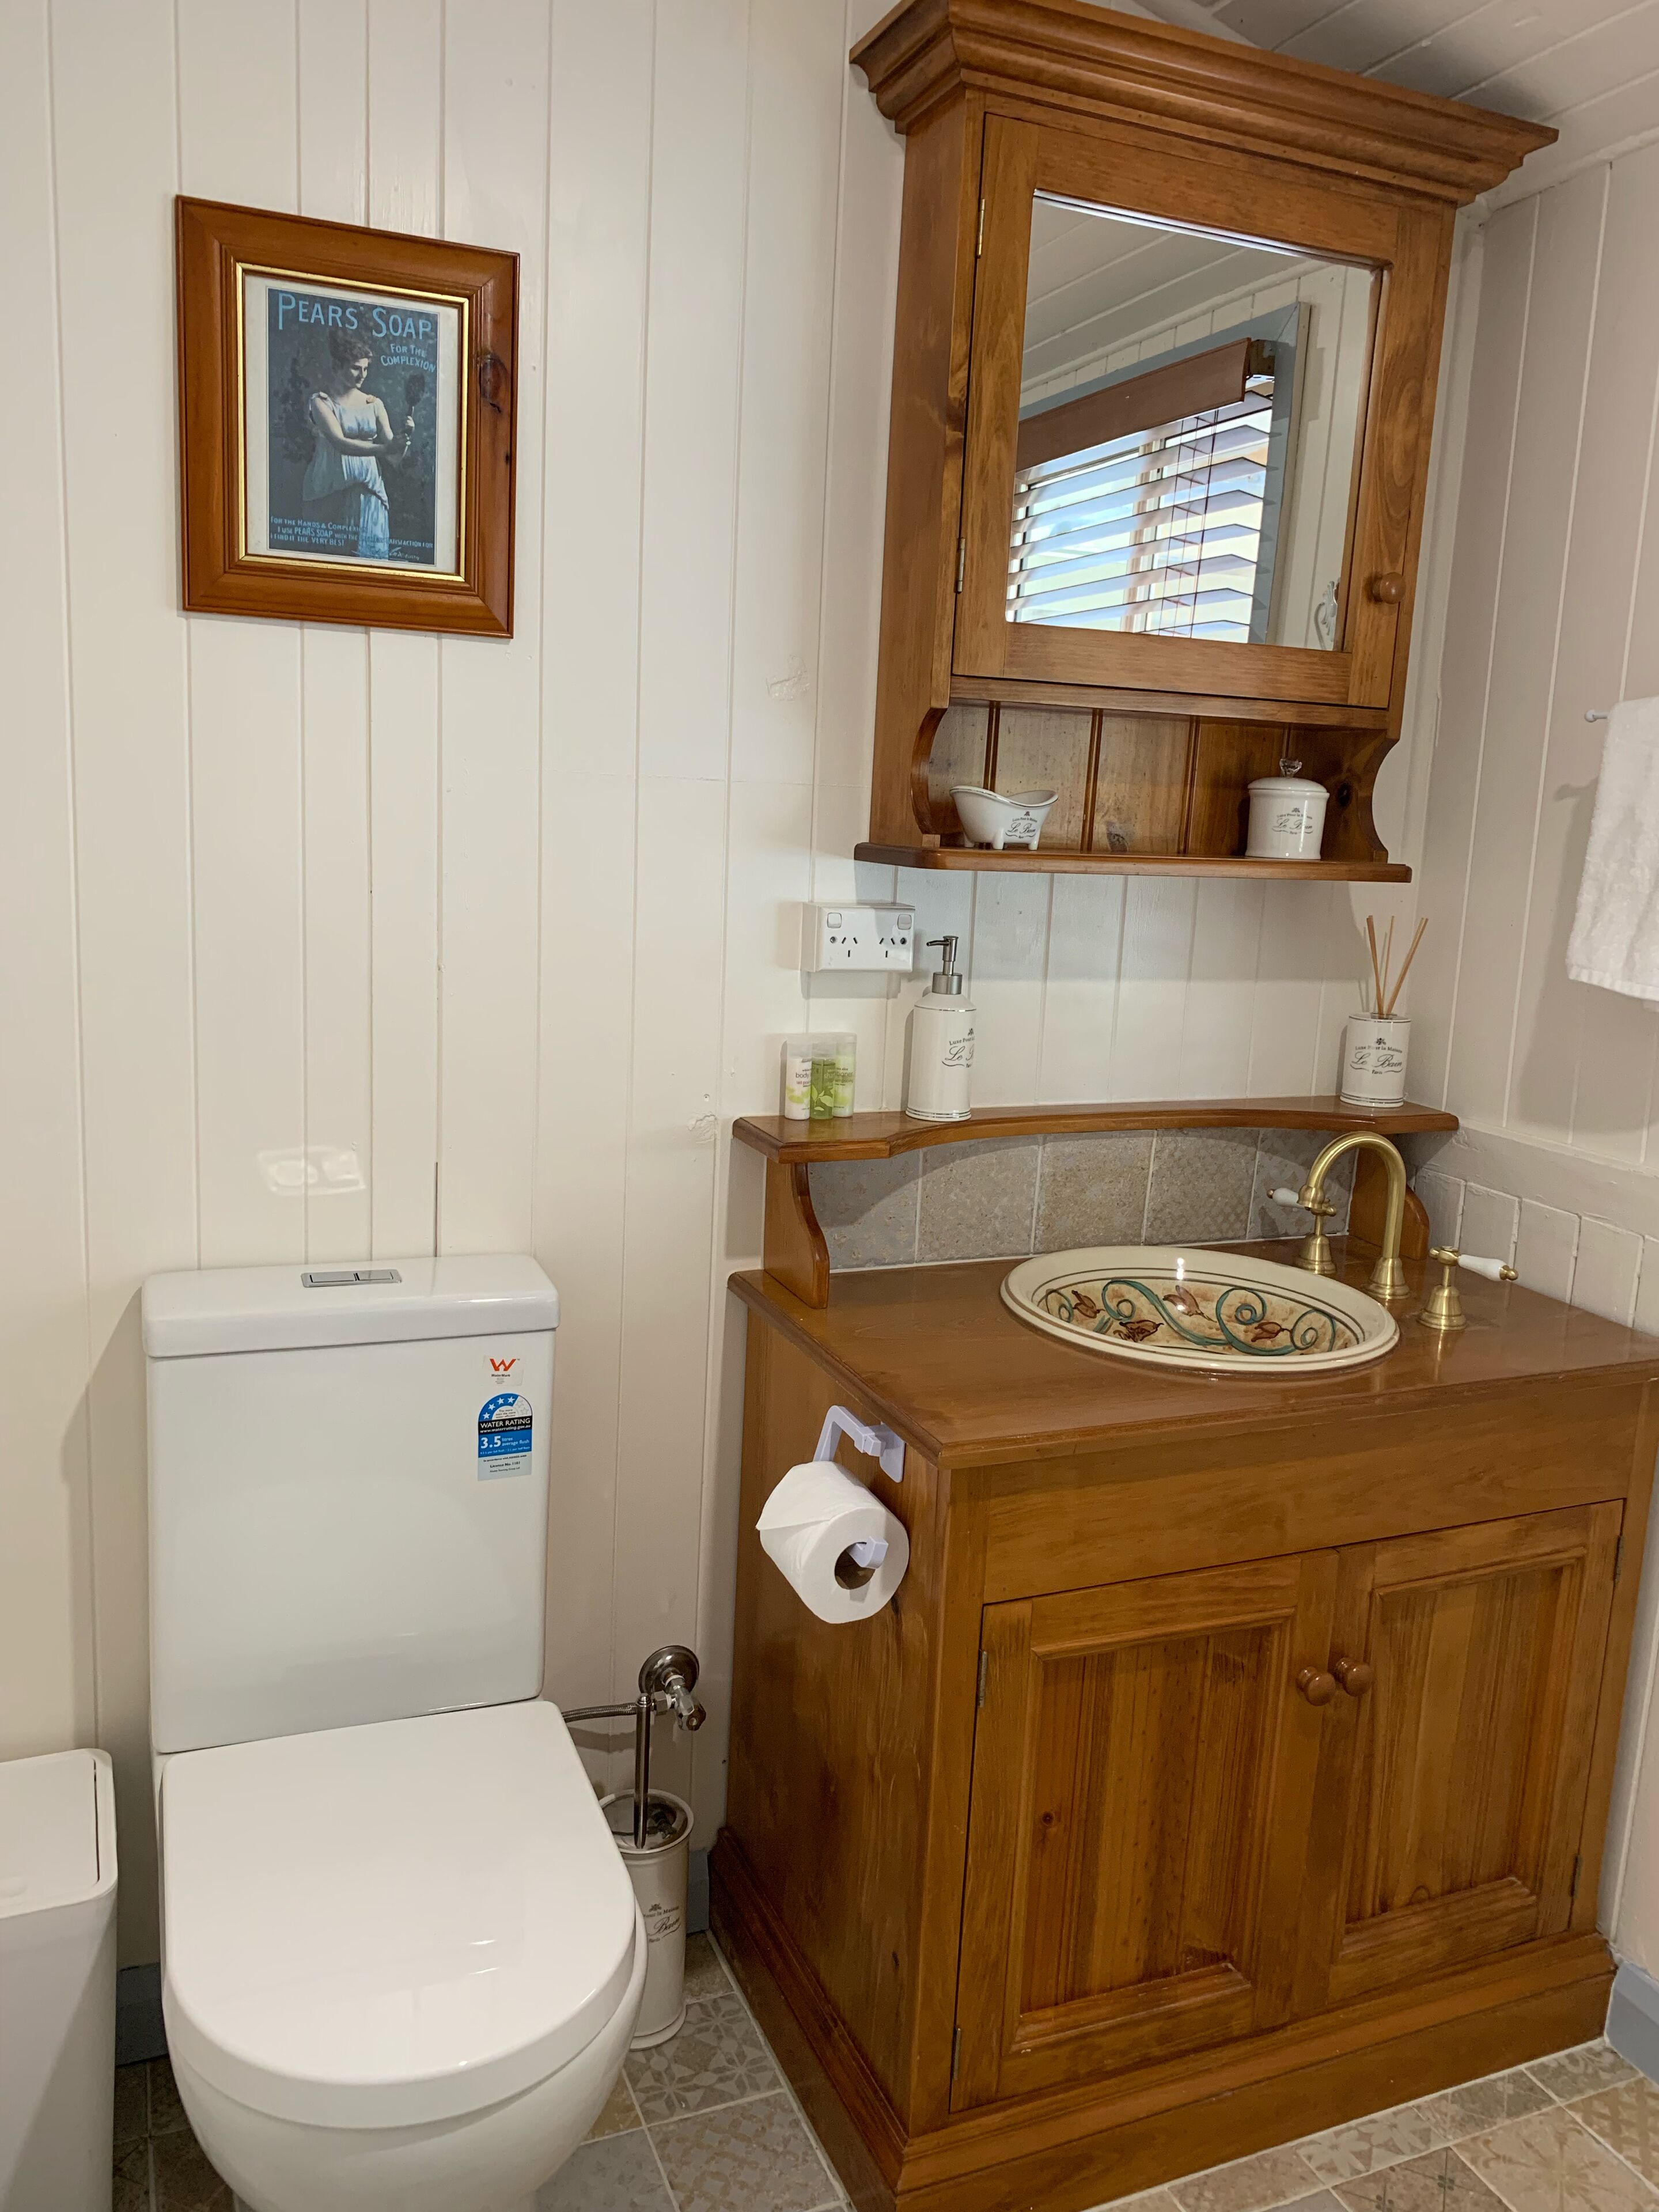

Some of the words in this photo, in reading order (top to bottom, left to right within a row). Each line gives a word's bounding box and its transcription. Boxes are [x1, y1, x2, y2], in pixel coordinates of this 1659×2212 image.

[372, 306, 432, 339] SOAP
[390, 343, 408, 354] FOR
[410, 346, 427, 357] THE
[381, 355, 436, 373] COMPLEXION
[298, 519, 320, 528] HANDS
[311, 537, 328, 545] VERY
[329, 538, 344, 546] BEST
[316, 529, 332, 537] SOAP
[389, 539, 421, 547] ATISFACTION
[945, 1046, 965, 1060] Le
[1351, 1051, 1371, 1065] Le
[480, 1421, 503, 1429] WATER
[480, 1425, 531, 1433] www.waterrating.gov.au
[480, 1435, 501, 1449] 3.5
